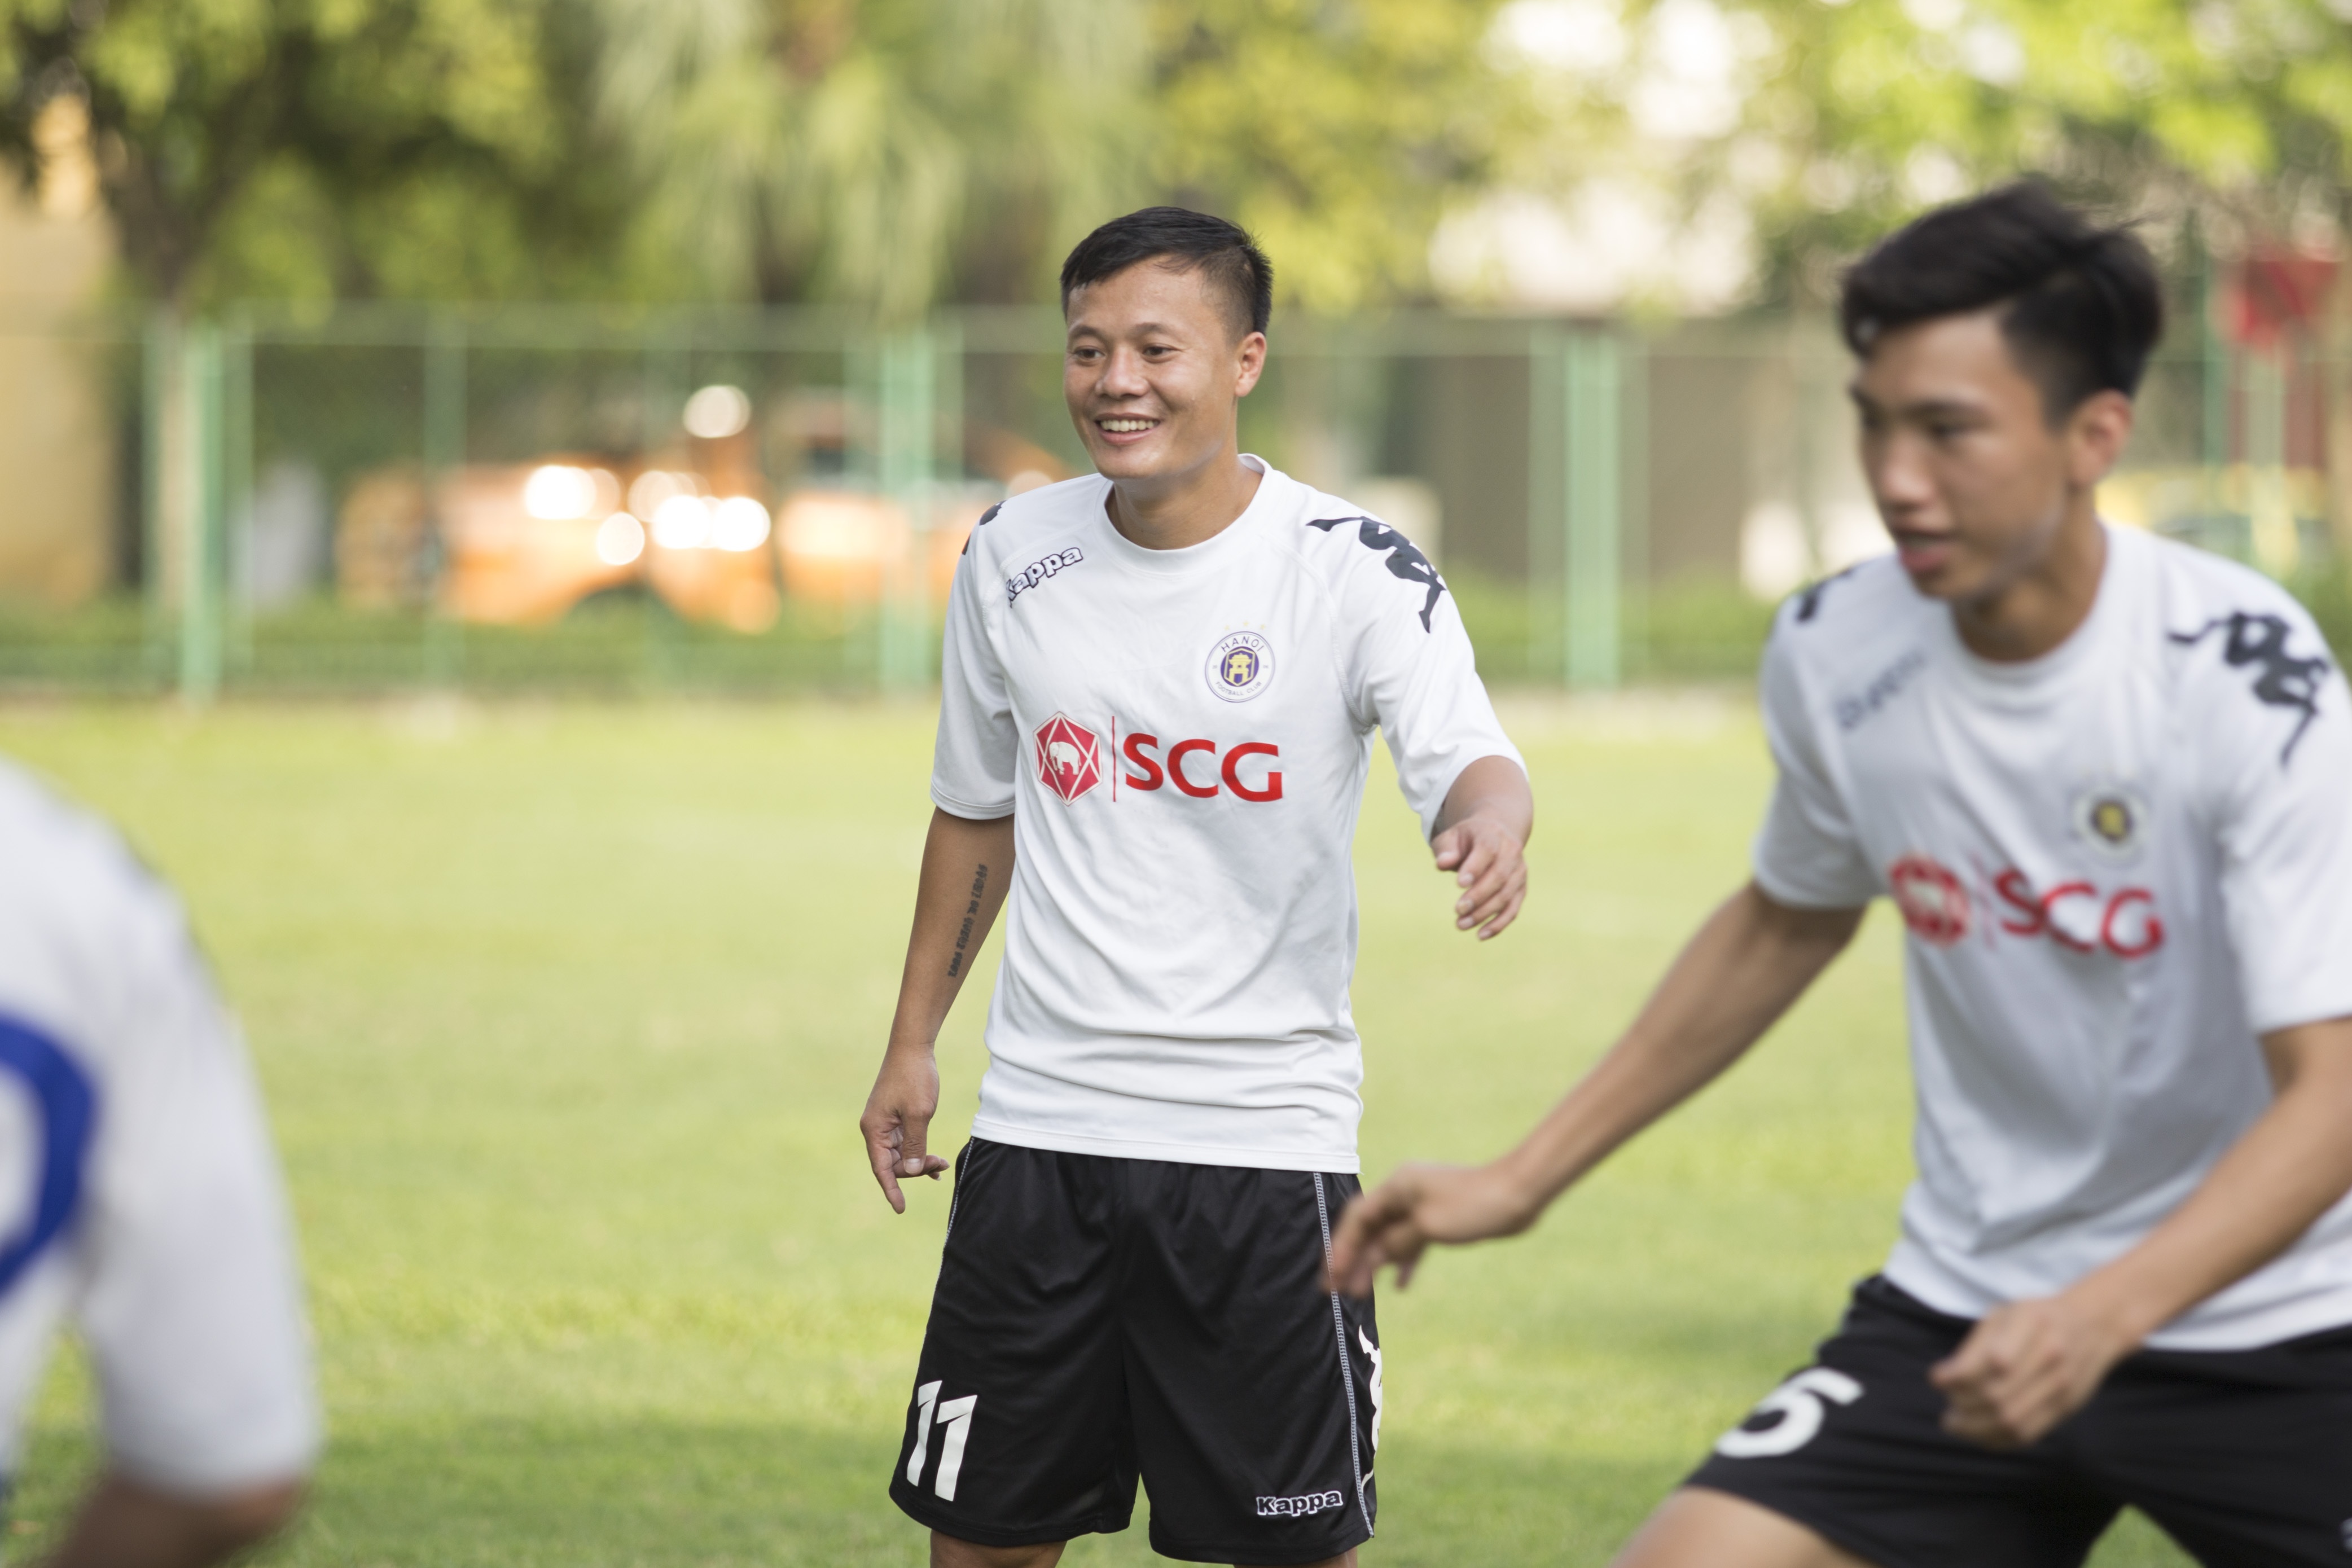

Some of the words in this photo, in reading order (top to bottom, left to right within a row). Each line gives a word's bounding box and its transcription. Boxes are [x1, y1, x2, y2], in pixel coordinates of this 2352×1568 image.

[1006, 547, 1083, 608] Kappa
[1221, 636, 1264, 652] HANOI
[1216, 681, 1244, 696] FOOTBALL
[1246, 681, 1262, 693] CLUB
[1123, 732, 1283, 802] SCG
[1993, 866, 2165, 960] SCG
[906, 1380, 978, 1503] 11
[1256, 1490, 1344, 1517] Kappa
